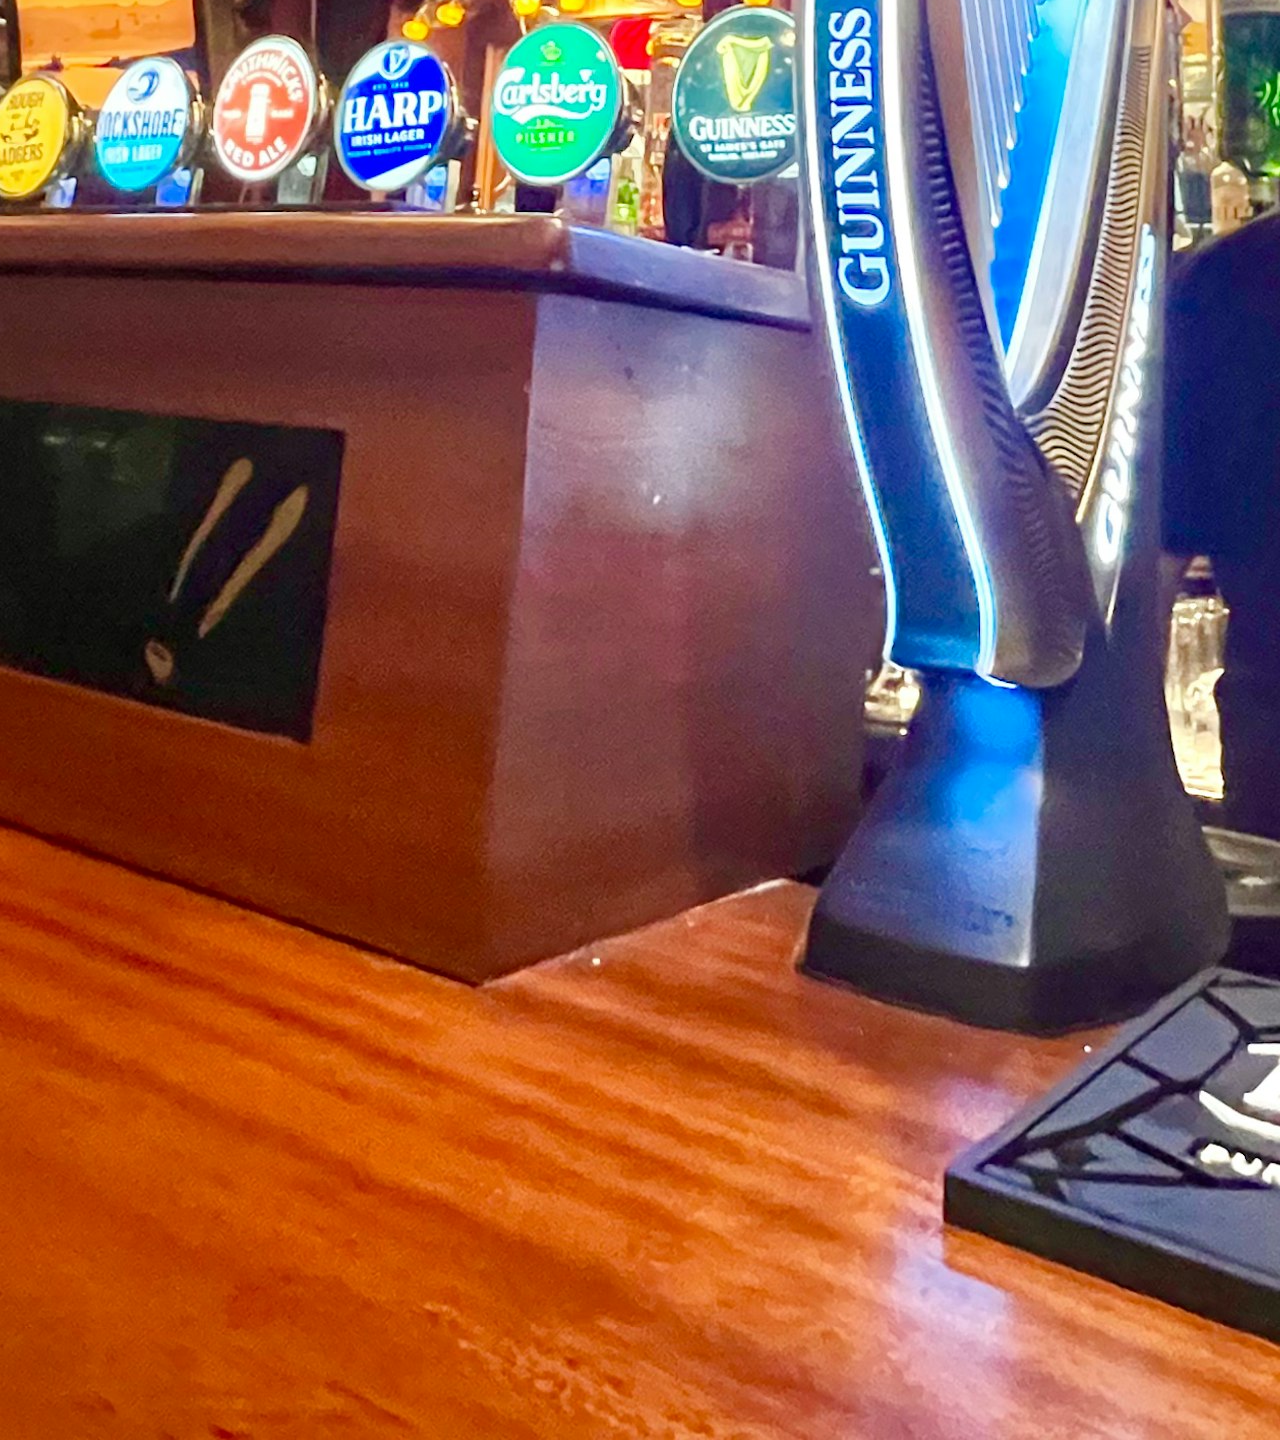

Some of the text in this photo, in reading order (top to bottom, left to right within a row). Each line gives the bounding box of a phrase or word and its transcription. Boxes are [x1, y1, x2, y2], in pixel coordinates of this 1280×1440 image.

[343, 90, 442, 133] HARP
[493, 67, 608, 116] Carlsberg
[384, 128, 425, 144] LAGER
[688, 114, 797, 141] GUINNESS
[827, 6, 892, 307] GUINNESS
